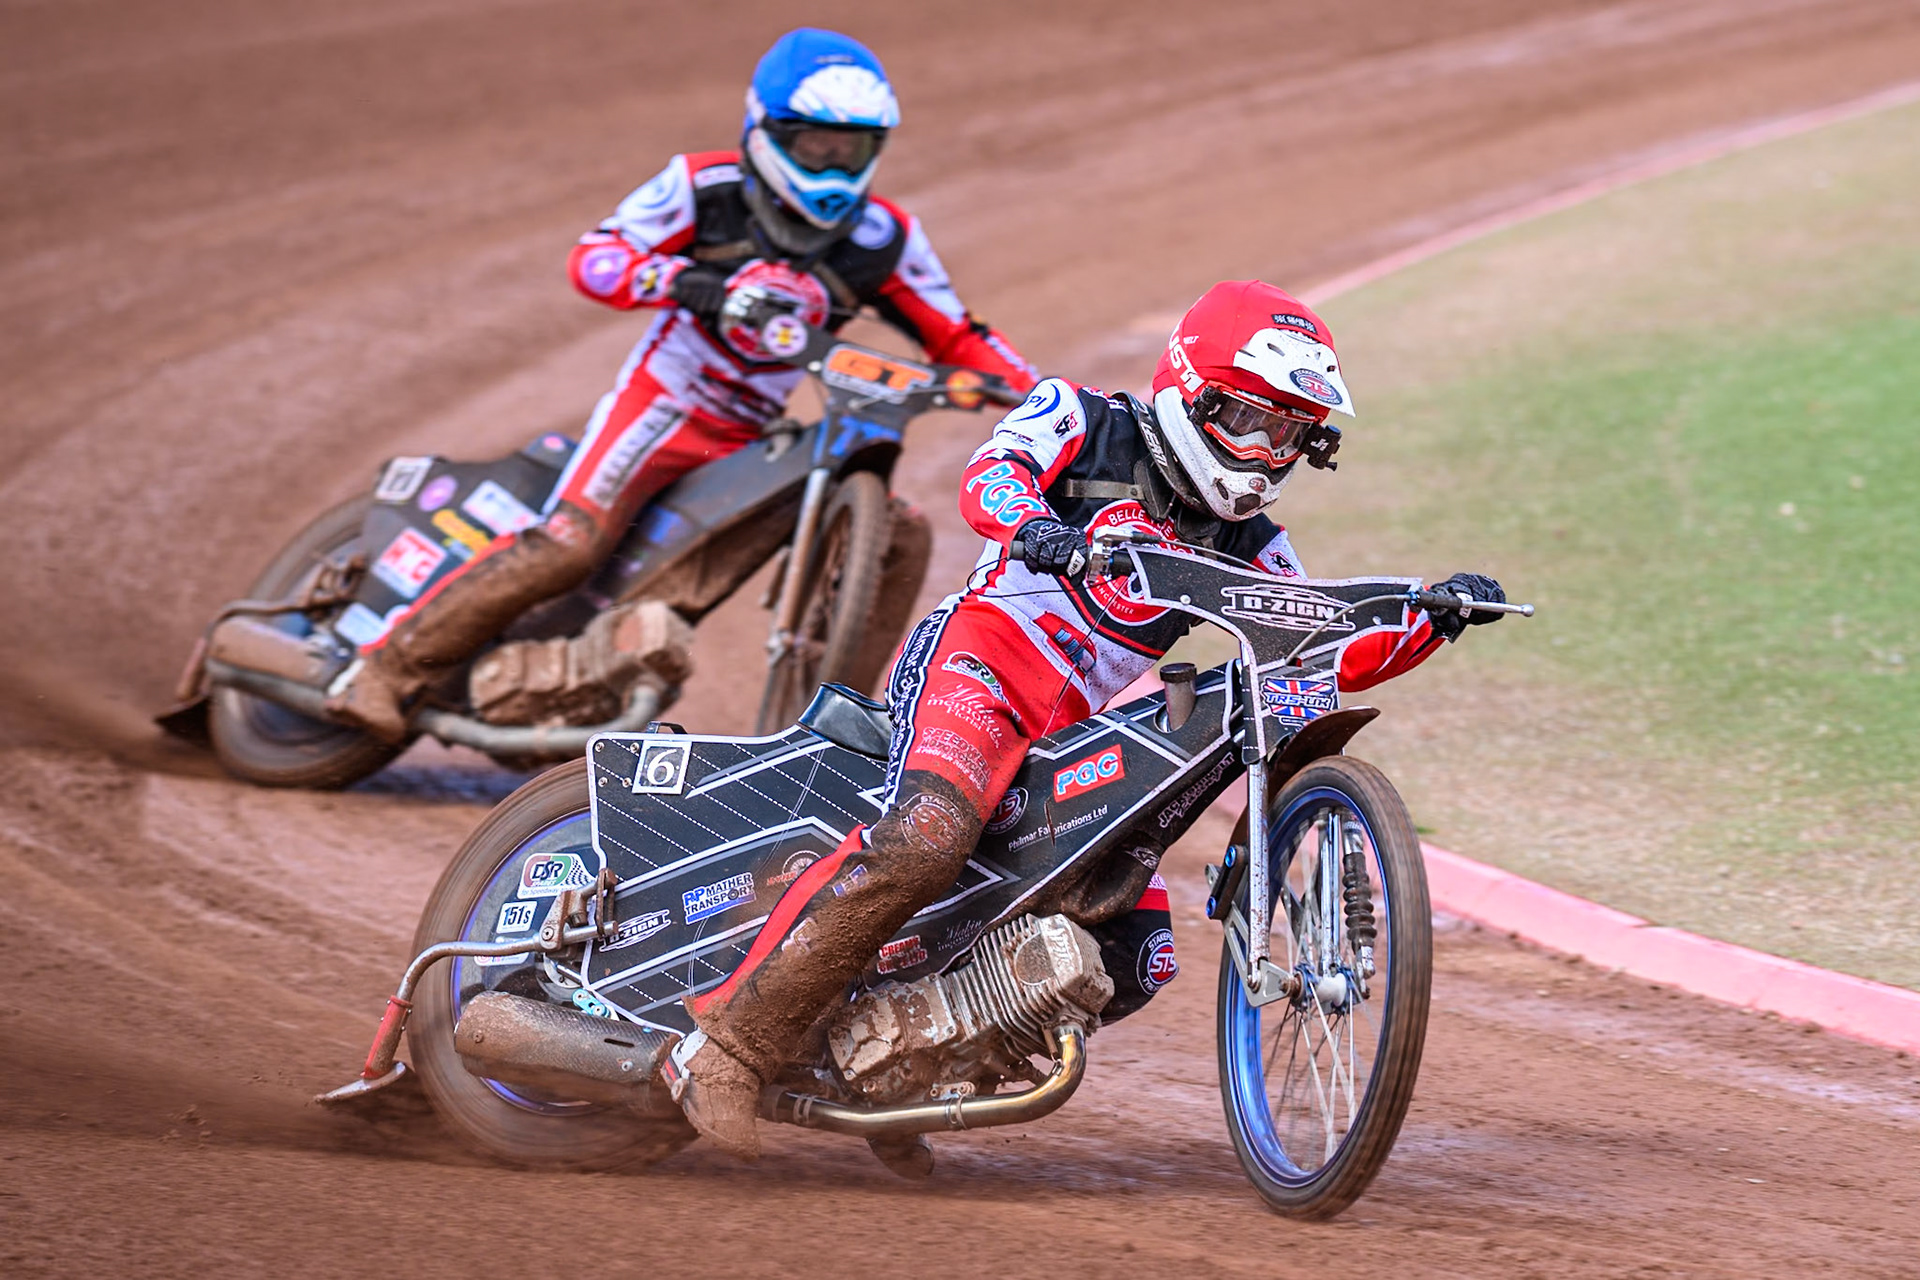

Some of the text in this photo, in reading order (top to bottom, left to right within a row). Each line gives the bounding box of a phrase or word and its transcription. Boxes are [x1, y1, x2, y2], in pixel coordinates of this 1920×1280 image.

[1299, 375, 1333, 396] STS
[965, 461, 1046, 527] PGC
[1107, 508, 1147, 526] BELLE
[1243, 595, 1336, 619] D-ZIGN
[1264, 692, 1332, 709] TRS-UK
[921, 726, 992, 777] SPEEDWELL
[647, 751, 677, 786] 6
[1056, 752, 1119, 796] PGC
[1008, 831, 1038, 851] Philmar
[1092, 803, 1109, 819] Ltd
[531, 860, 563, 881] DSR
[705, 873, 753, 897] MATHER
[685, 884, 754, 916] TRANSPORT
[503, 906, 532, 926] 151s
[609, 917, 660, 944] D-ZIGN
[1149, 952, 1178, 974] STS
